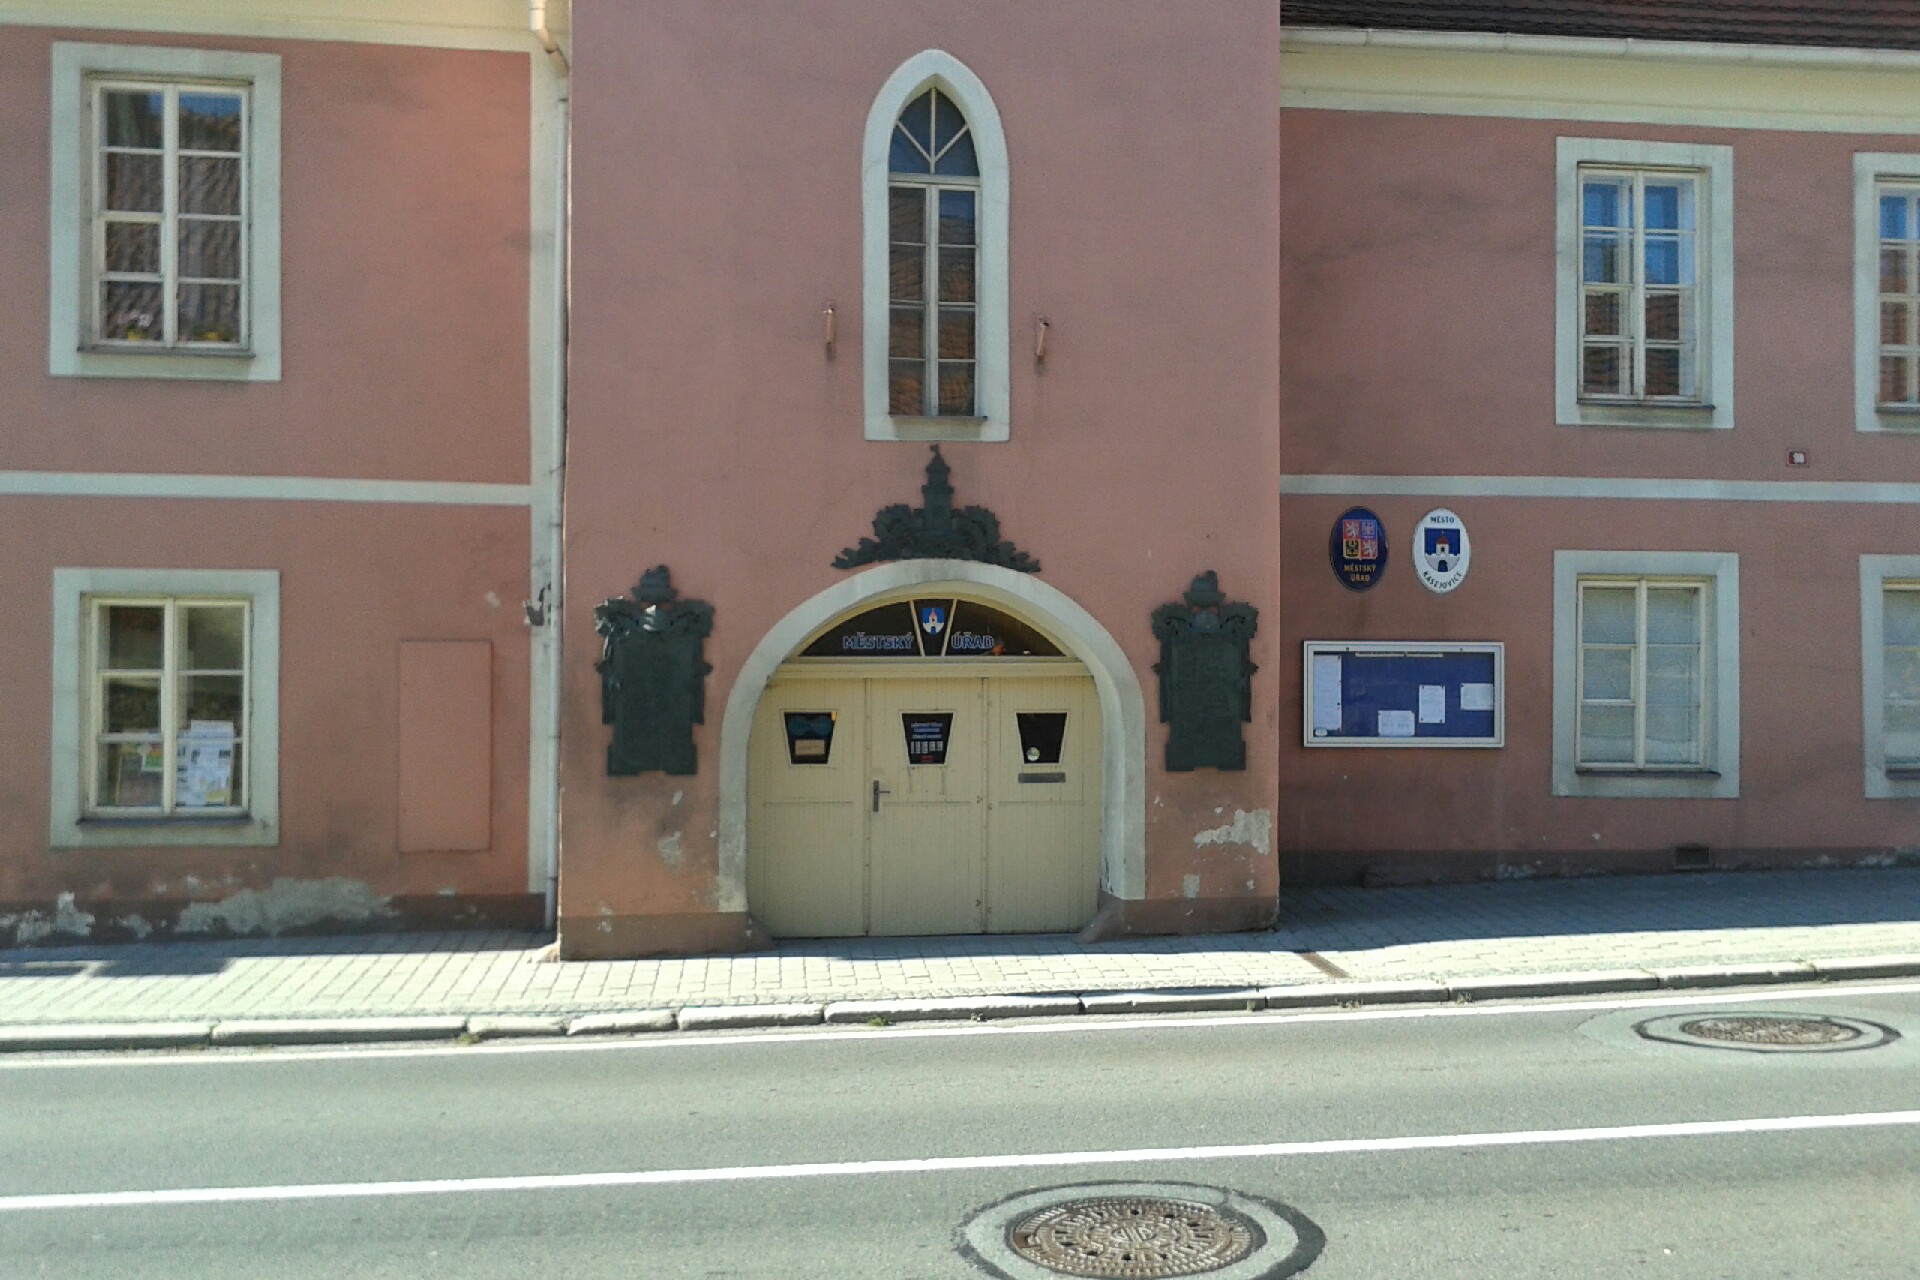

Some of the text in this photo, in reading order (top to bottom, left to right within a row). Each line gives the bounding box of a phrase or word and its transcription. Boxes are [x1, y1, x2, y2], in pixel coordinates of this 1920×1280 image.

[1430, 515, 1454, 523] MĚSTO
[1344, 563, 1376, 572] MĚSTSKÝ
[1351, 573, 1371, 582] ÚŘAD
[843, 632, 994, 648] MĚSTSKÝ ÚŘAD
